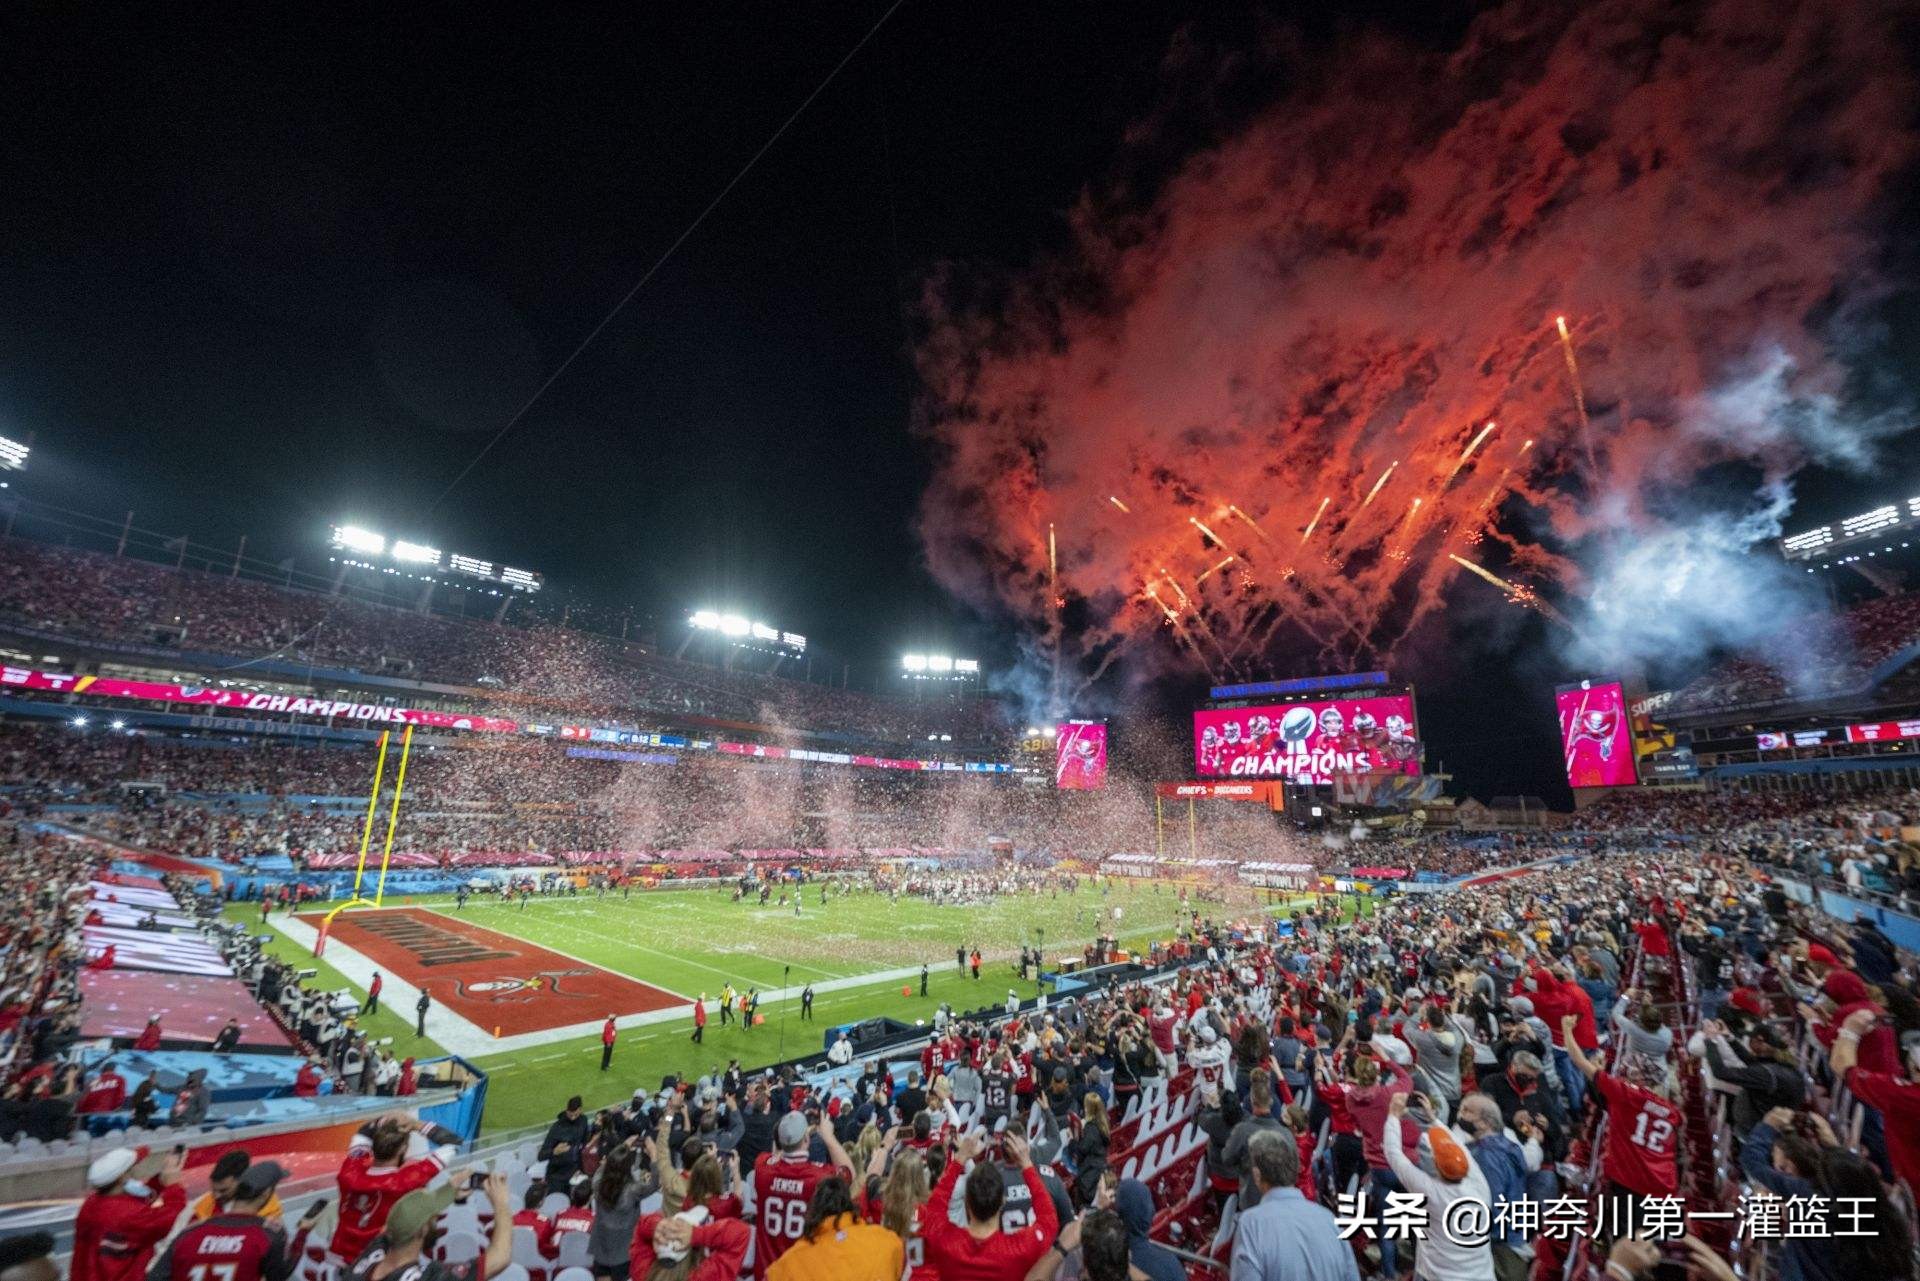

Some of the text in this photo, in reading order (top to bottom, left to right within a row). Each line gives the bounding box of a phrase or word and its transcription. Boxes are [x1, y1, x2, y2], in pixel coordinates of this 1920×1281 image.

[247, 693, 408, 723] CHAMPIONS
[1631, 692, 1673, 716] SUPER
[1230, 748, 1373, 775] CHAMPIONS
[1177, 785, 1208, 795] CHIEFS
[985, 1088, 1006, 1107] 12
[1630, 1112, 1674, 1153] 12
[769, 1177, 805, 1194] JENSEN
[764, 1196, 808, 1239] 66
[197, 1234, 247, 1254] EVANS
